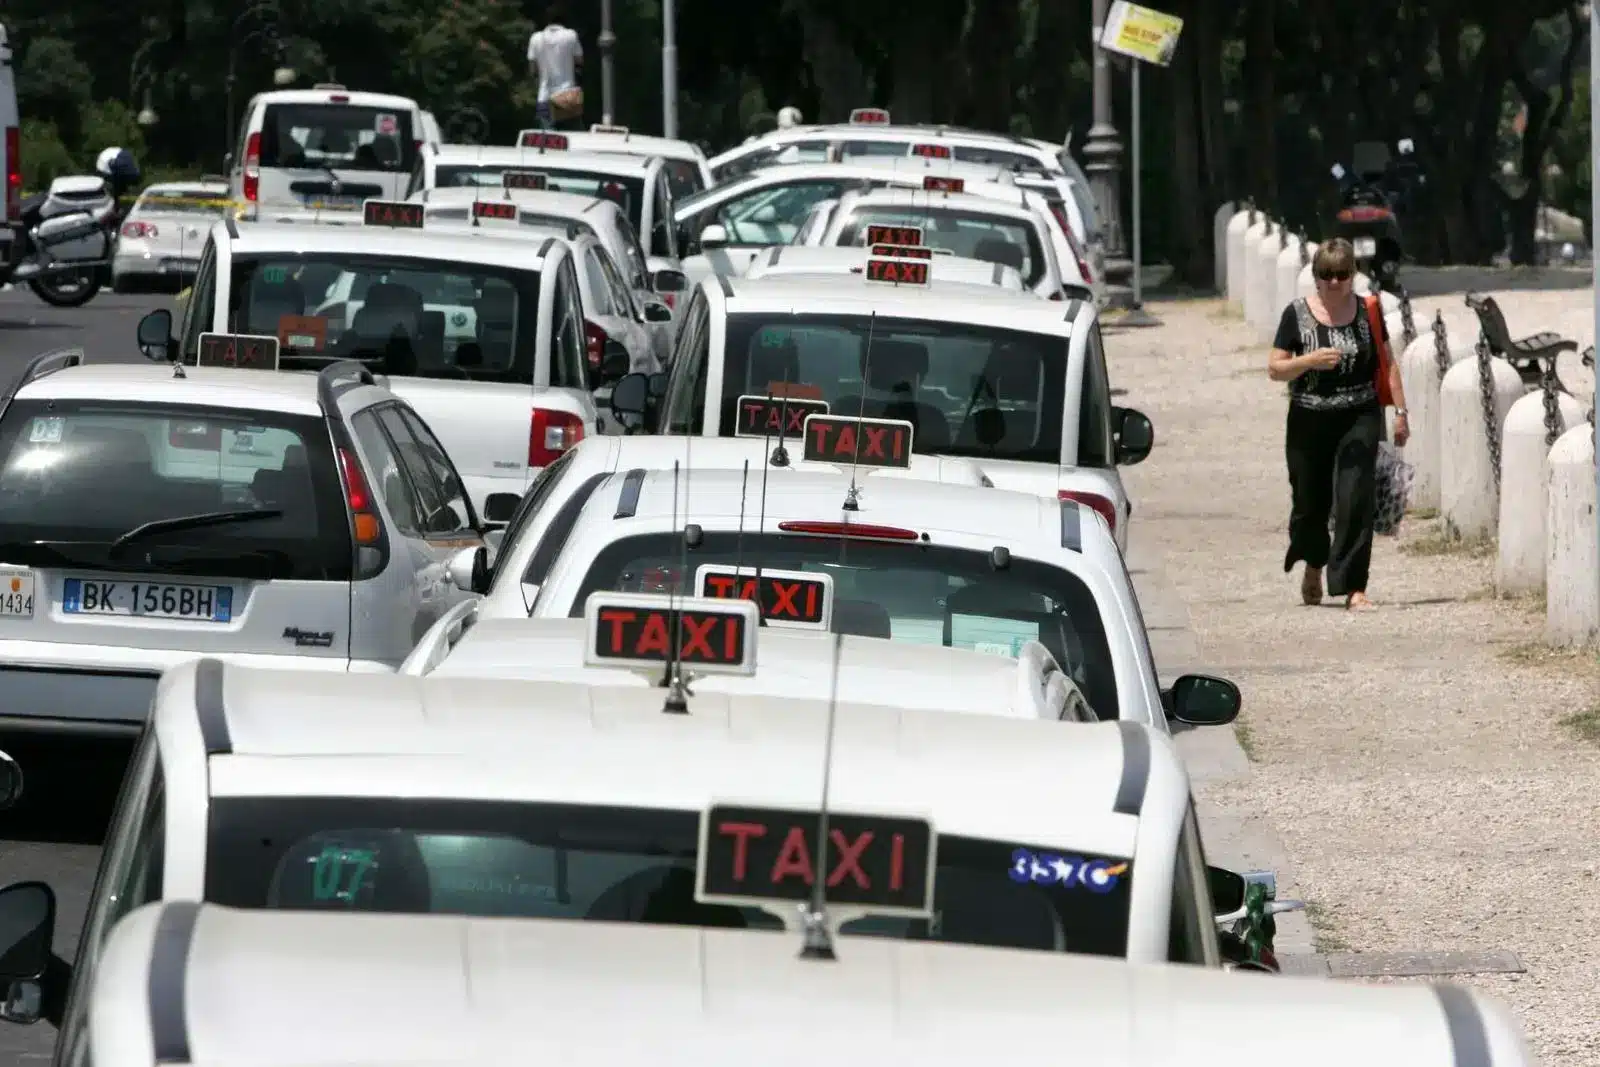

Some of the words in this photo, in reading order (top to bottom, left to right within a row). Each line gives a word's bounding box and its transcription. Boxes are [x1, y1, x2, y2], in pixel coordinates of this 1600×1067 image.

[370, 205, 422, 222] TAXI
[478, 201, 516, 218] TAXI
[871, 228, 919, 245] TAXI
[871, 261, 926, 282] TAXI
[206, 340, 268, 362] TAXI
[744, 404, 814, 432] TAX
[810, 423, 904, 460] TAXI
[83, 583, 116, 611] BK
[131, 584, 213, 617] 156BH
[601, 611, 739, 660] TAXI
[719, 822, 904, 891] TAXI
[313, 847, 374, 902] 07
